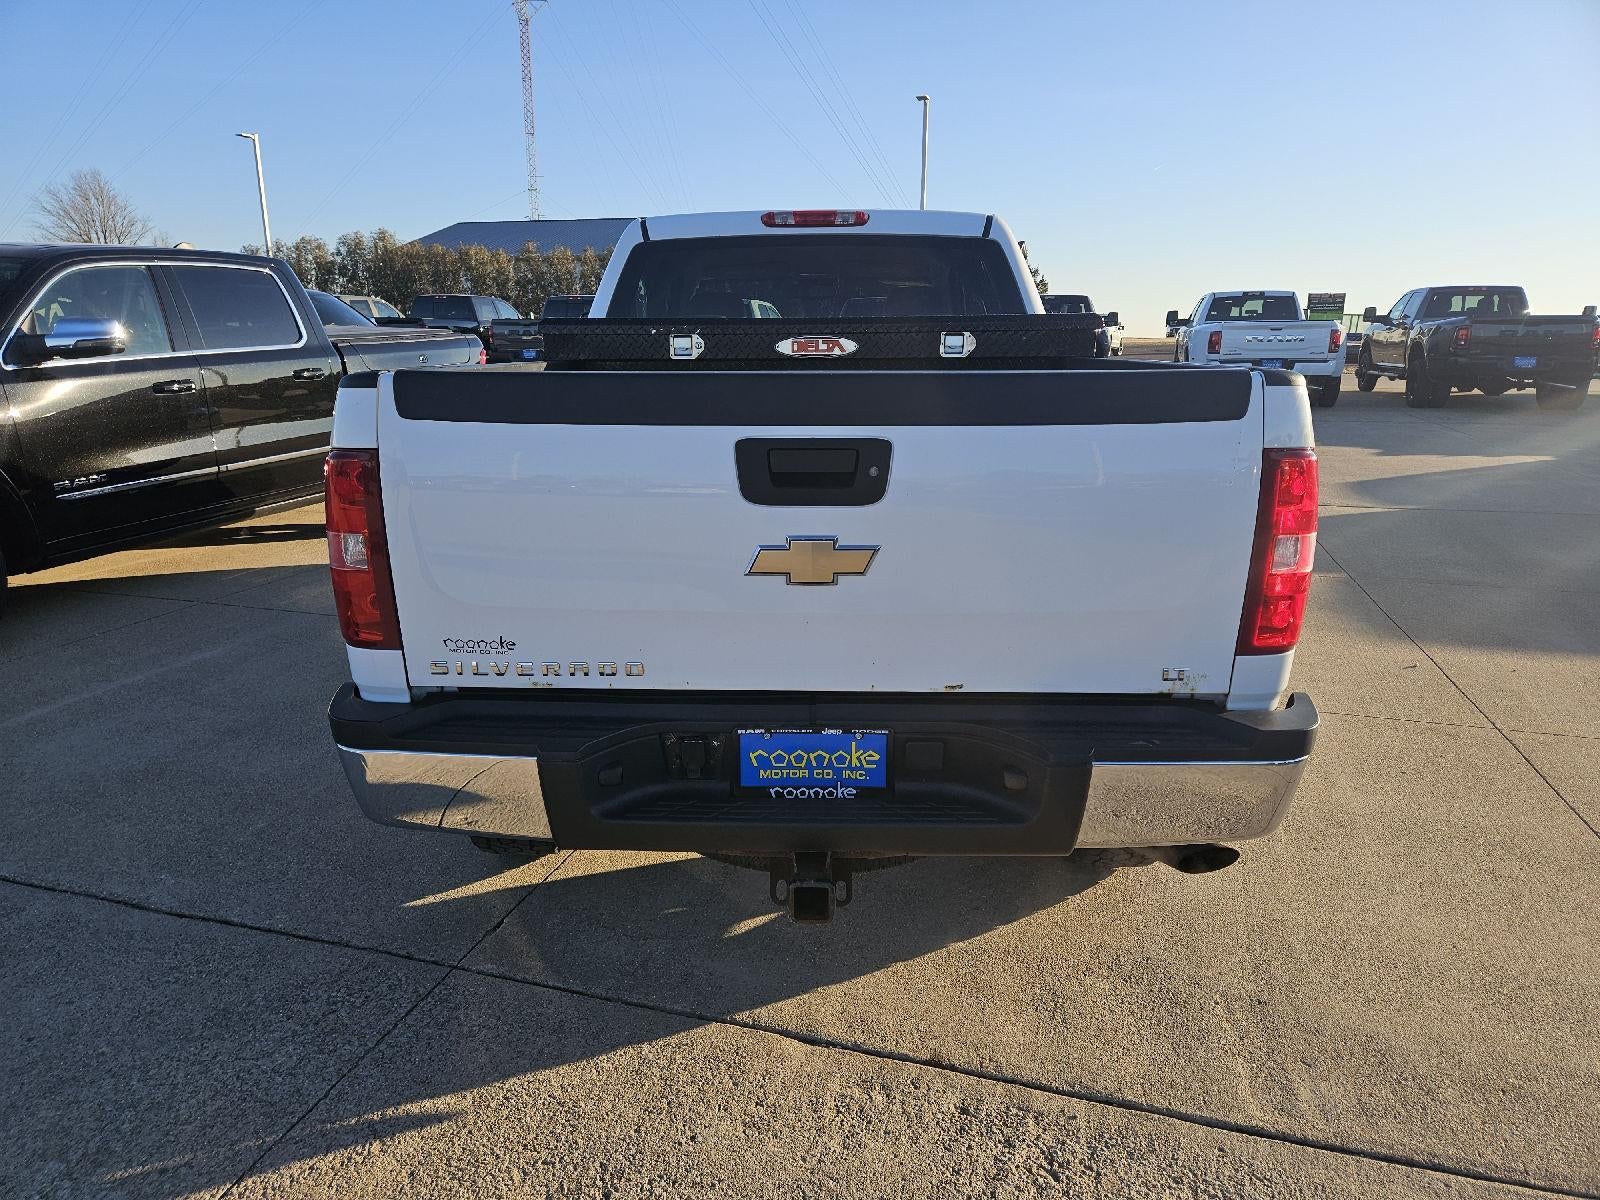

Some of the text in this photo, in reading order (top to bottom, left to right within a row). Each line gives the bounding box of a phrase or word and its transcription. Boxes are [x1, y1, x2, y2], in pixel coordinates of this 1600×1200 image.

[1245, 334, 1306, 343] RAM
[791, 339, 847, 354] DELTA
[429, 660, 646, 677] SILVERADO
[1162, 667, 1191, 682] LT
[821, 727, 843, 736] Jeep
[759, 769, 870, 780] MOTOR CO. INC.
